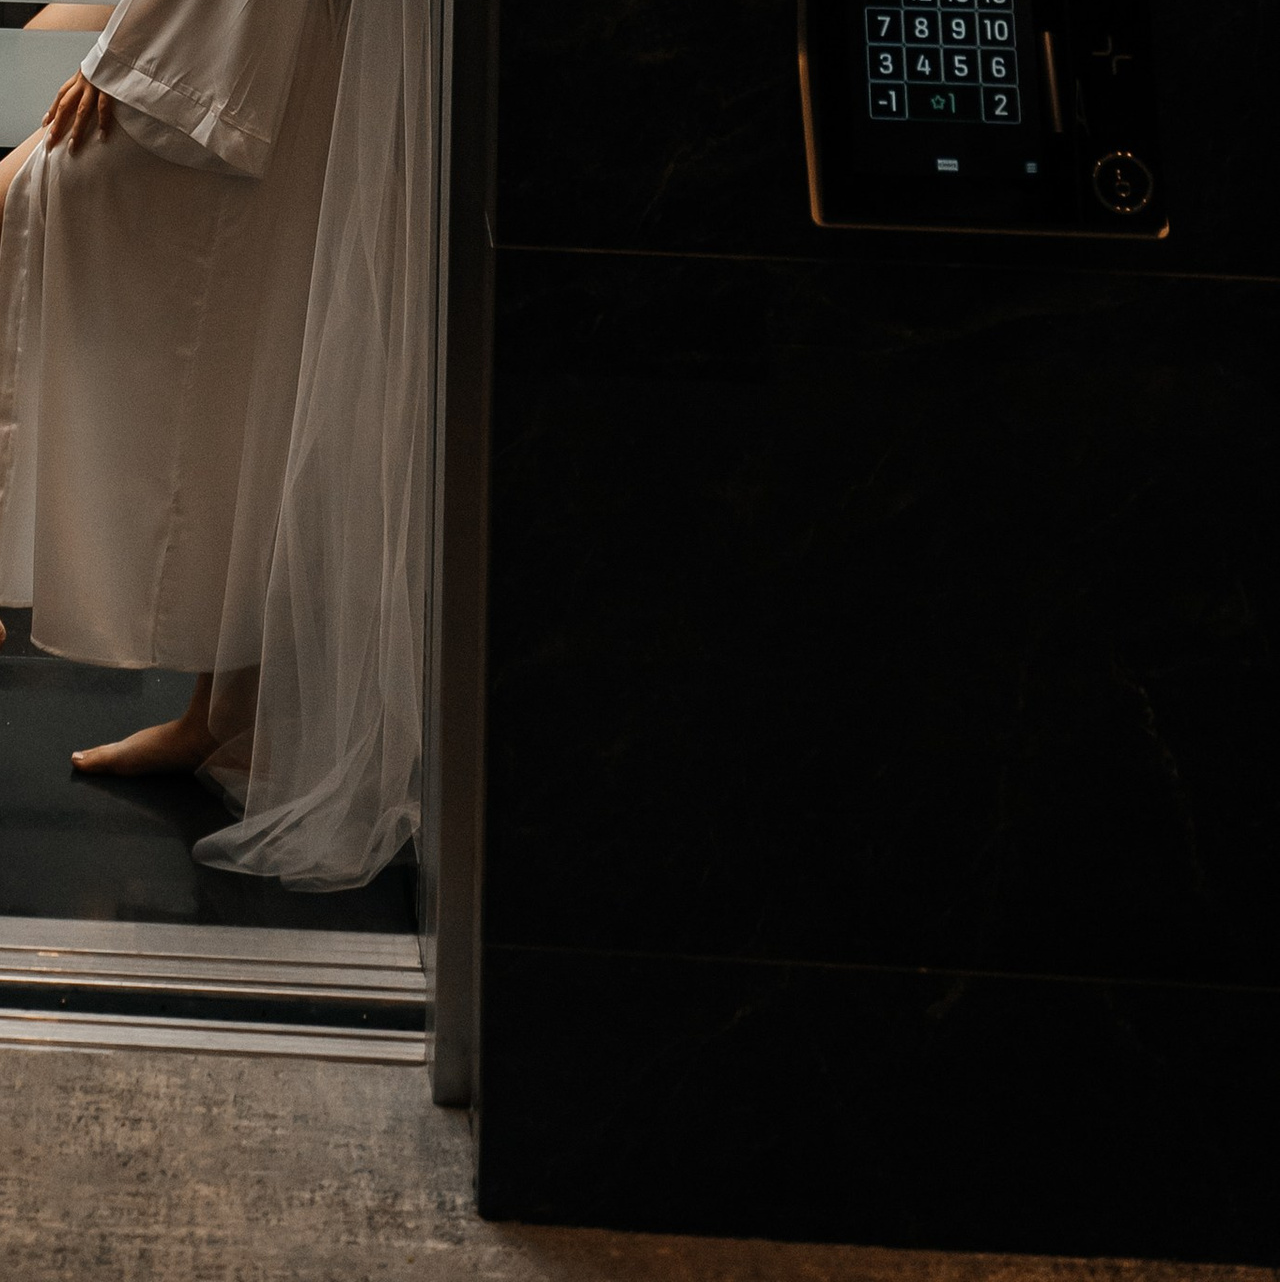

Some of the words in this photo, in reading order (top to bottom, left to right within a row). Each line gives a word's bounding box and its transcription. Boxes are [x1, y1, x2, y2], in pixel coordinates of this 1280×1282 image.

[877, 15, 891, 37] 7
[914, 17, 929, 39] 8
[951, 18, 966, 40] 9
[983, 19, 1009, 41] 10
[879, 52, 894, 75] 3
[916, 54, 932, 76] 4
[954, 55, 969, 77] 5
[991, 56, 1006, 78] 6
[878, 90, 897, 112] -1
[994, 93, 1009, 116] 2
